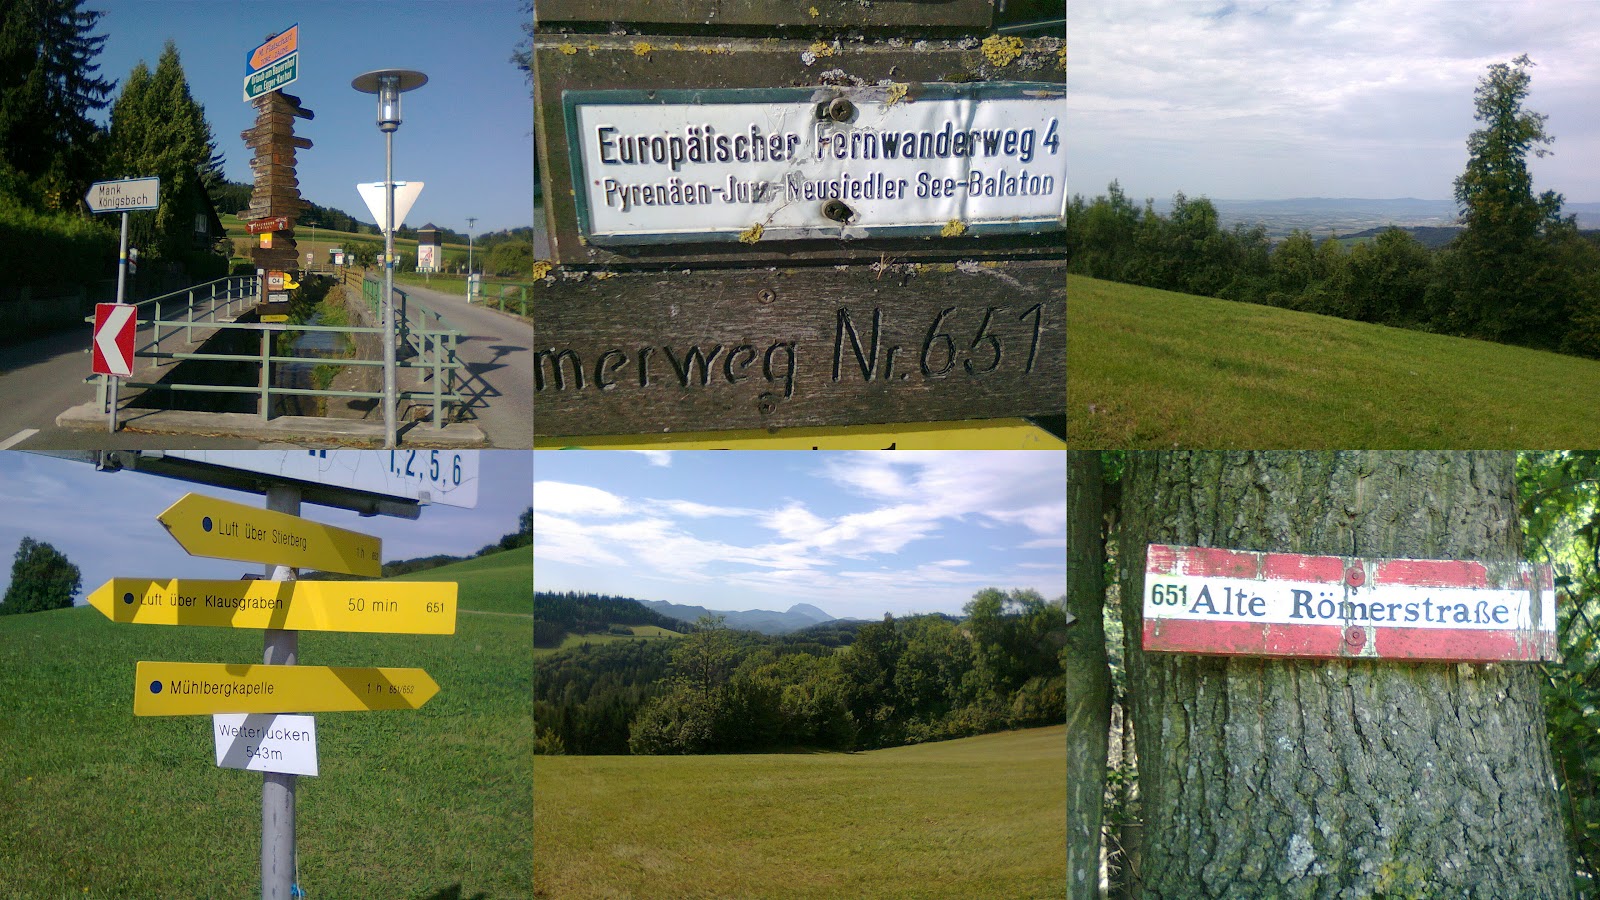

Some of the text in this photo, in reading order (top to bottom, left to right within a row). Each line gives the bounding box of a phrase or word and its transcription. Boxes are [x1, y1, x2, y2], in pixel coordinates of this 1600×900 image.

[251, 56, 295, 85] Urlaub am Bauernhof
[597, 117, 1061, 172] Europäischer Fernwanderweg 4
[99, 184, 121, 196] Mank
[915, 168, 1055, 199] See-Balaton
[99, 193, 148, 208] Königsbach
[218, 517, 239, 539] Luft
[245, 522, 267, 543] über
[272, 528, 307, 552] Stierberg
[140, 593, 445, 613] Luft über Klausgraben 50 min 651
[1151, 583, 1510, 625] 651 Alte Römerstraße
[170, 680, 275, 698] Mühlbergkapelle
[376, 683, 382, 693] h
[389, 684, 415, 694] 651/652
[219, 724, 310, 742] Wetterlucken
[246, 745, 283, 761] 543m
